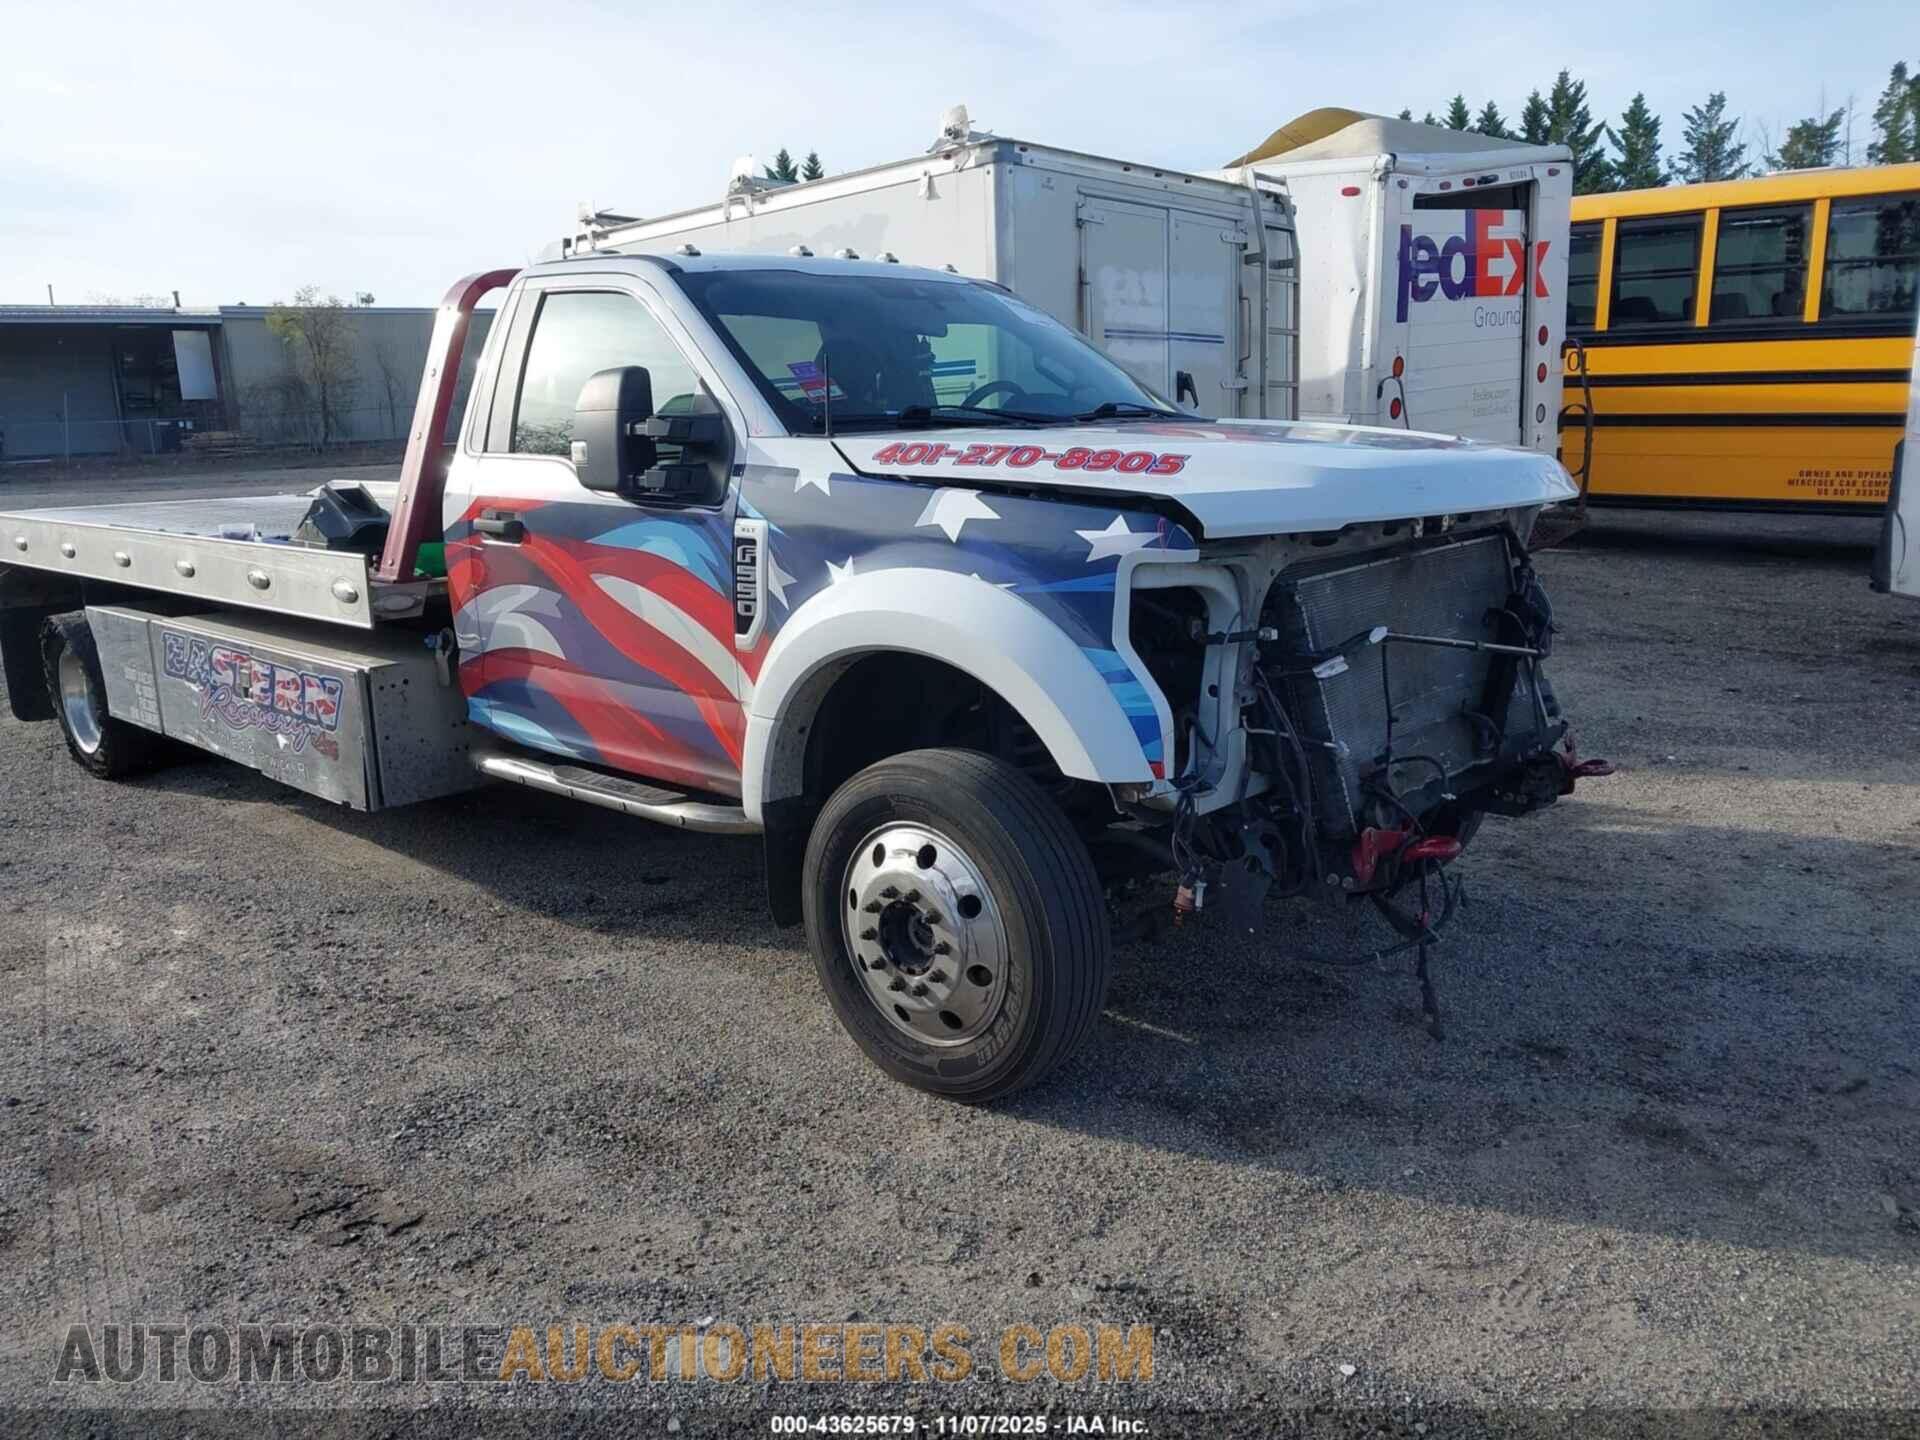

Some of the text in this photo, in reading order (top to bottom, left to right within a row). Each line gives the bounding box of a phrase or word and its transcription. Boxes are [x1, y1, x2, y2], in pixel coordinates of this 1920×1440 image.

[1473, 306, 1521, 328] Ground
[872, 442, 1192, 476] 401-270-8905
[163, 632, 343, 732] EASTERN
[202, 682, 312, 753] Recovery
